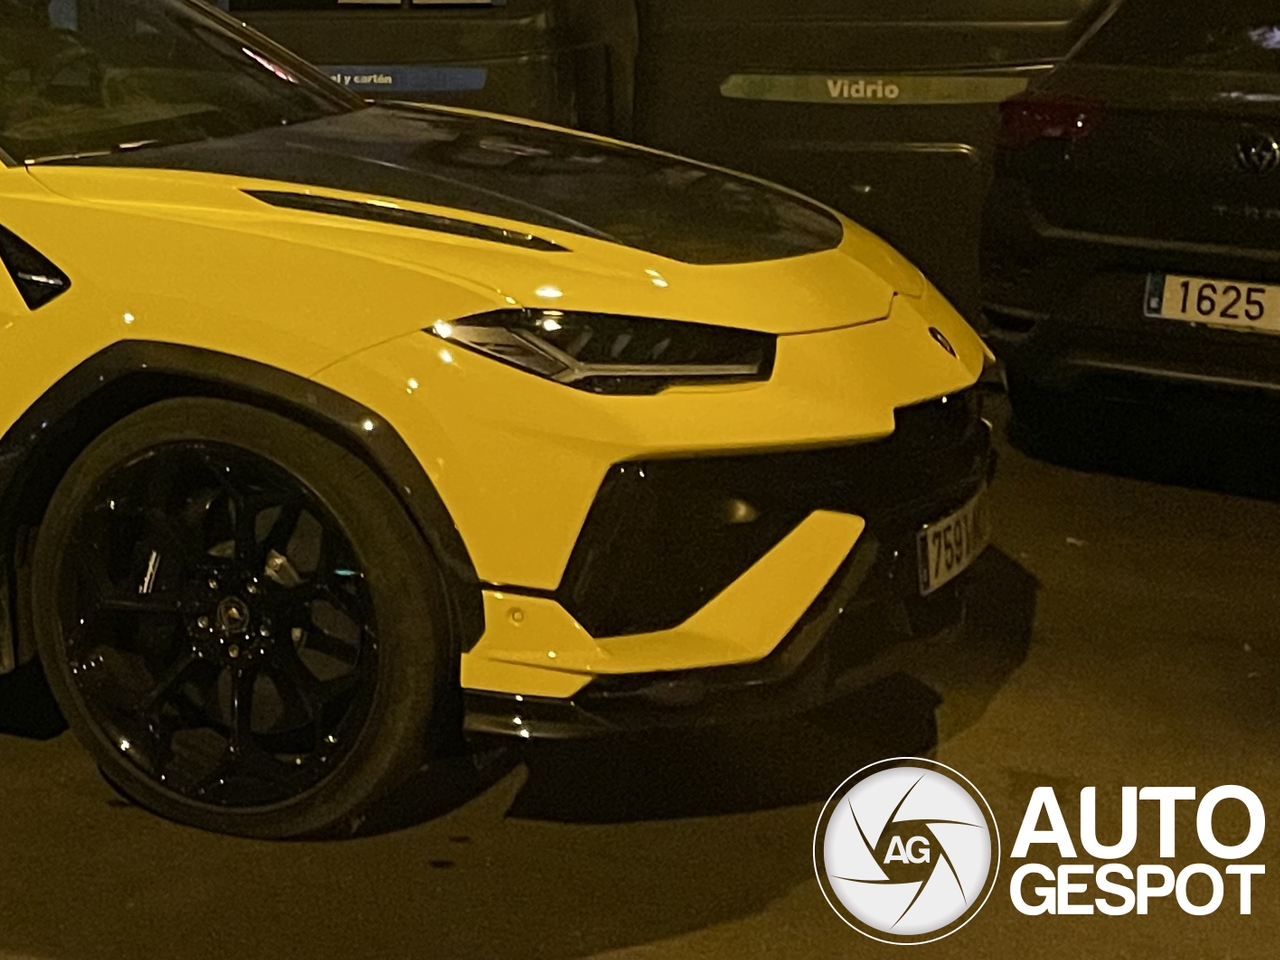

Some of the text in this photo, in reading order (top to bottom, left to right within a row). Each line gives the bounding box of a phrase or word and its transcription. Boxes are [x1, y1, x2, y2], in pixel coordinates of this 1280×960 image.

[344, 75, 352, 85] y
[826, 79, 899, 98] Vidrio
[1180, 280, 1266, 321] 1625
